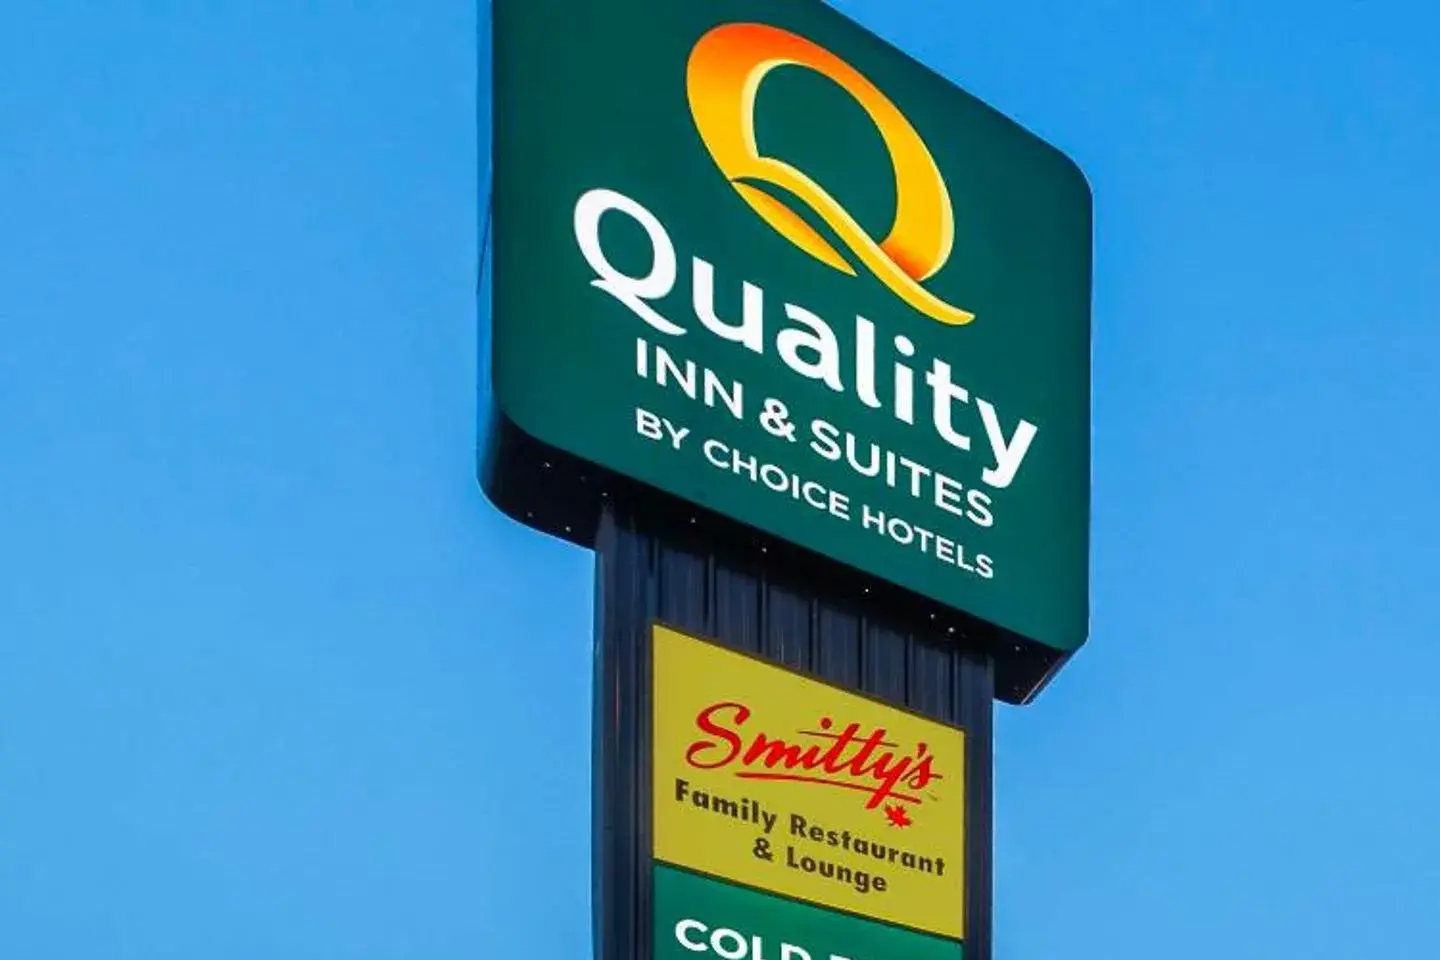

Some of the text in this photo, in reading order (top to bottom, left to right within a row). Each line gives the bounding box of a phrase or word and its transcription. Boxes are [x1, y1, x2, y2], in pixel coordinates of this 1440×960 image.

[573, 188, 1038, 490] Quality
[636, 337, 995, 529] INN & SUITES
[636, 408, 994, 579] BY CHOICE HOTELS
[686, 702, 943, 810] Smitty's
[675, 778, 946, 877] Family Restaurant
[752, 838, 888, 894] & Lounge
